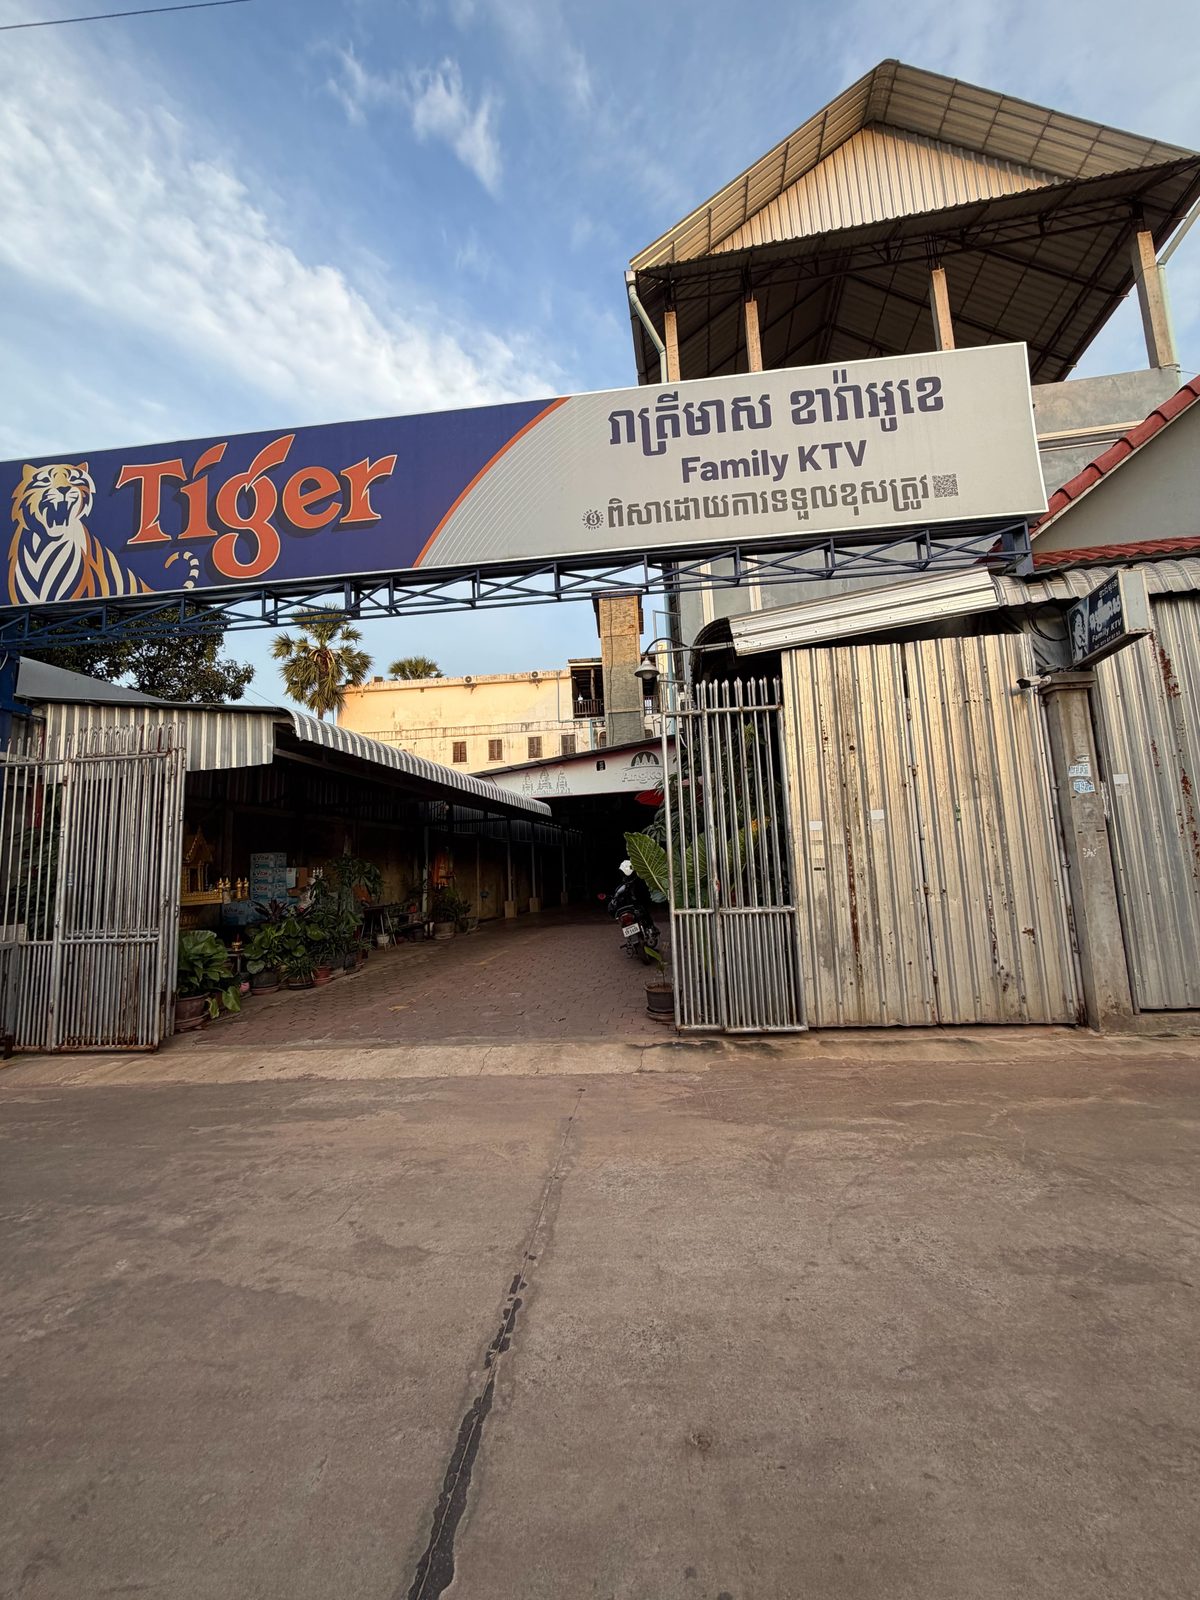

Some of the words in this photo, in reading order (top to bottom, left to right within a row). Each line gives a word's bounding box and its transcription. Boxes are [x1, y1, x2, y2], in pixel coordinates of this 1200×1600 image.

[607, 391, 772, 457] រាត្រីមាស
[789, 369, 944, 432] ខារ៉ាអូខេ
[681, 448, 789, 483] Family
[798, 440, 867, 472] KTV
[115, 433, 398, 580] Tiger
[606, 474, 930, 529] ពិសាដោយការទទួលខុសត្រូវ
[1111, 618, 1122, 631] KTV
[622, 771, 663, 784] Angko
